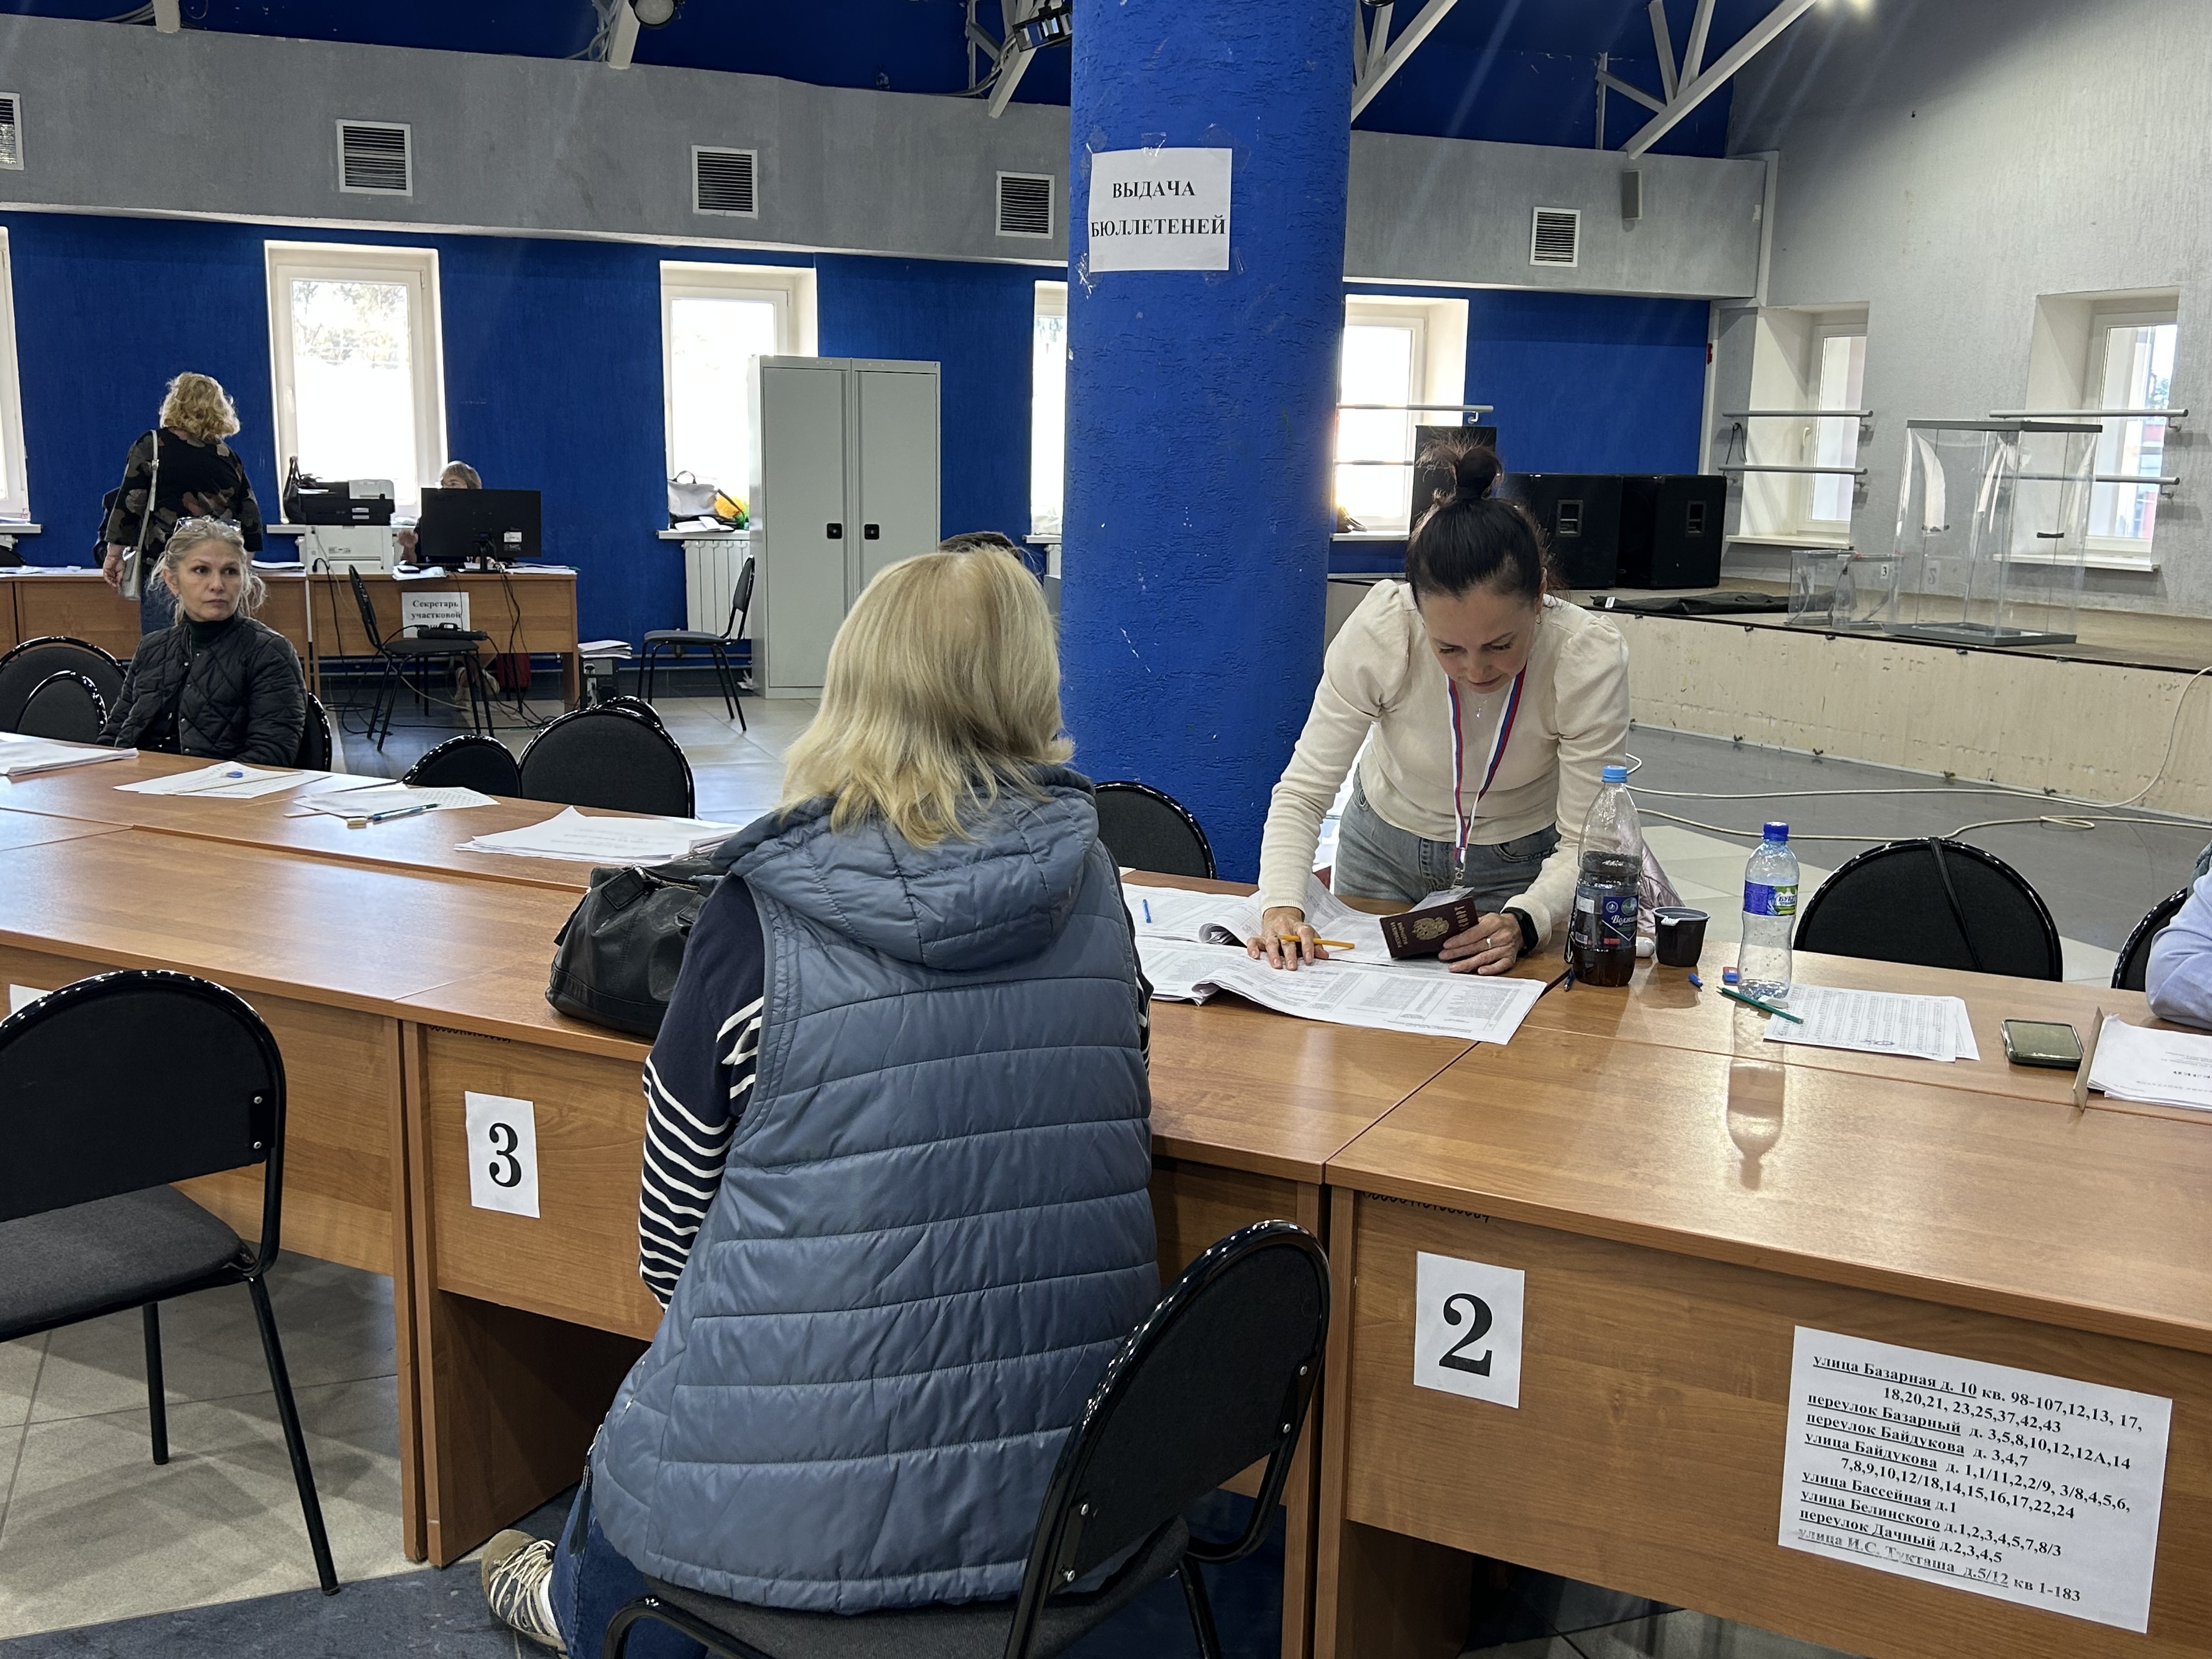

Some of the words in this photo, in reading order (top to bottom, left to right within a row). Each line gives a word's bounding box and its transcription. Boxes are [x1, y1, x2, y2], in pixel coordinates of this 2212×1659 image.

[1113, 180, 1195, 201] ВЫДАЧА
[1091, 215, 1226, 238] БЮЛЛЕТЕНЕЙ
[1882, 566, 1887, 577] 3
[411, 611, 461, 620] участковой
[413, 600, 459, 609] Секретарь
[489, 1122, 522, 1188] 3
[1438, 1293, 1493, 1377] 2
[1813, 1356, 1859, 1373] улица
[1864, 1362, 1936, 1387] Базарная
[1940, 1380, 1954, 1392] д.
[1961, 1381, 1977, 1395] 10
[1982, 1389, 2005, 1401] кв.
[2011, 1392, 2114, 1425] 98-107,12,13,
[2120, 1414, 2142, 1432] 17,
[1883, 1387, 1948, 1412] 18,20,21,
[1953, 1401, 2061, 1433] 23,25,37,42,43
[1807, 1414, 1876, 1435] переулок
[1881, 1426, 1964, 1454] Байдукова
[1973, 1448, 1987, 1459] д.
[1991, 1449, 2028, 1467] 3,4,7
[1808, 1395, 1878, 1416] переулок
[1882, 1407, 1961, 1433] Базарный
[1968, 1427, 1983, 1438] д.
[1988, 1429, 2130, 1469] 3,5,8,10,12,12А,14
[1802, 1472, 1847, 1488] улица
[1852, 1479, 1931, 1508] Бассейная
[1934, 1501, 1956, 1513] д.1
[1805, 1433, 1849, 1449] улица
[1855, 1441, 1938, 1469] Байдукова
[1945, 1463, 1959, 1474] д.
[1965, 1464, 2055, 1496] 1,1/11,2,2/9,
[2059, 1485, 2130, 1513] 3/8,4,5,6,
[1800, 1510, 1869, 1532] переулок
[1872, 1523, 1936, 1548] Дачный
[1939, 1541, 2002, 1563] д.2,3,4,5
[1801, 1491, 1845, 1507] улица
[1851, 1498, 1941, 1529] Белинского
[1944, 1523, 2061, 1556] д.1,2,3,4,5,7,8/3
[1798, 1528, 1842, 1545] улица
[1848, 1536, 1880, 1555] И.С.
[1885, 1545, 1955, 1572] Тукташа
[1963, 1567, 2008, 1584] д.5/12
[2014, 1578, 2033, 1590] кв
[2040, 1582, 2080, 1601] 1-183
